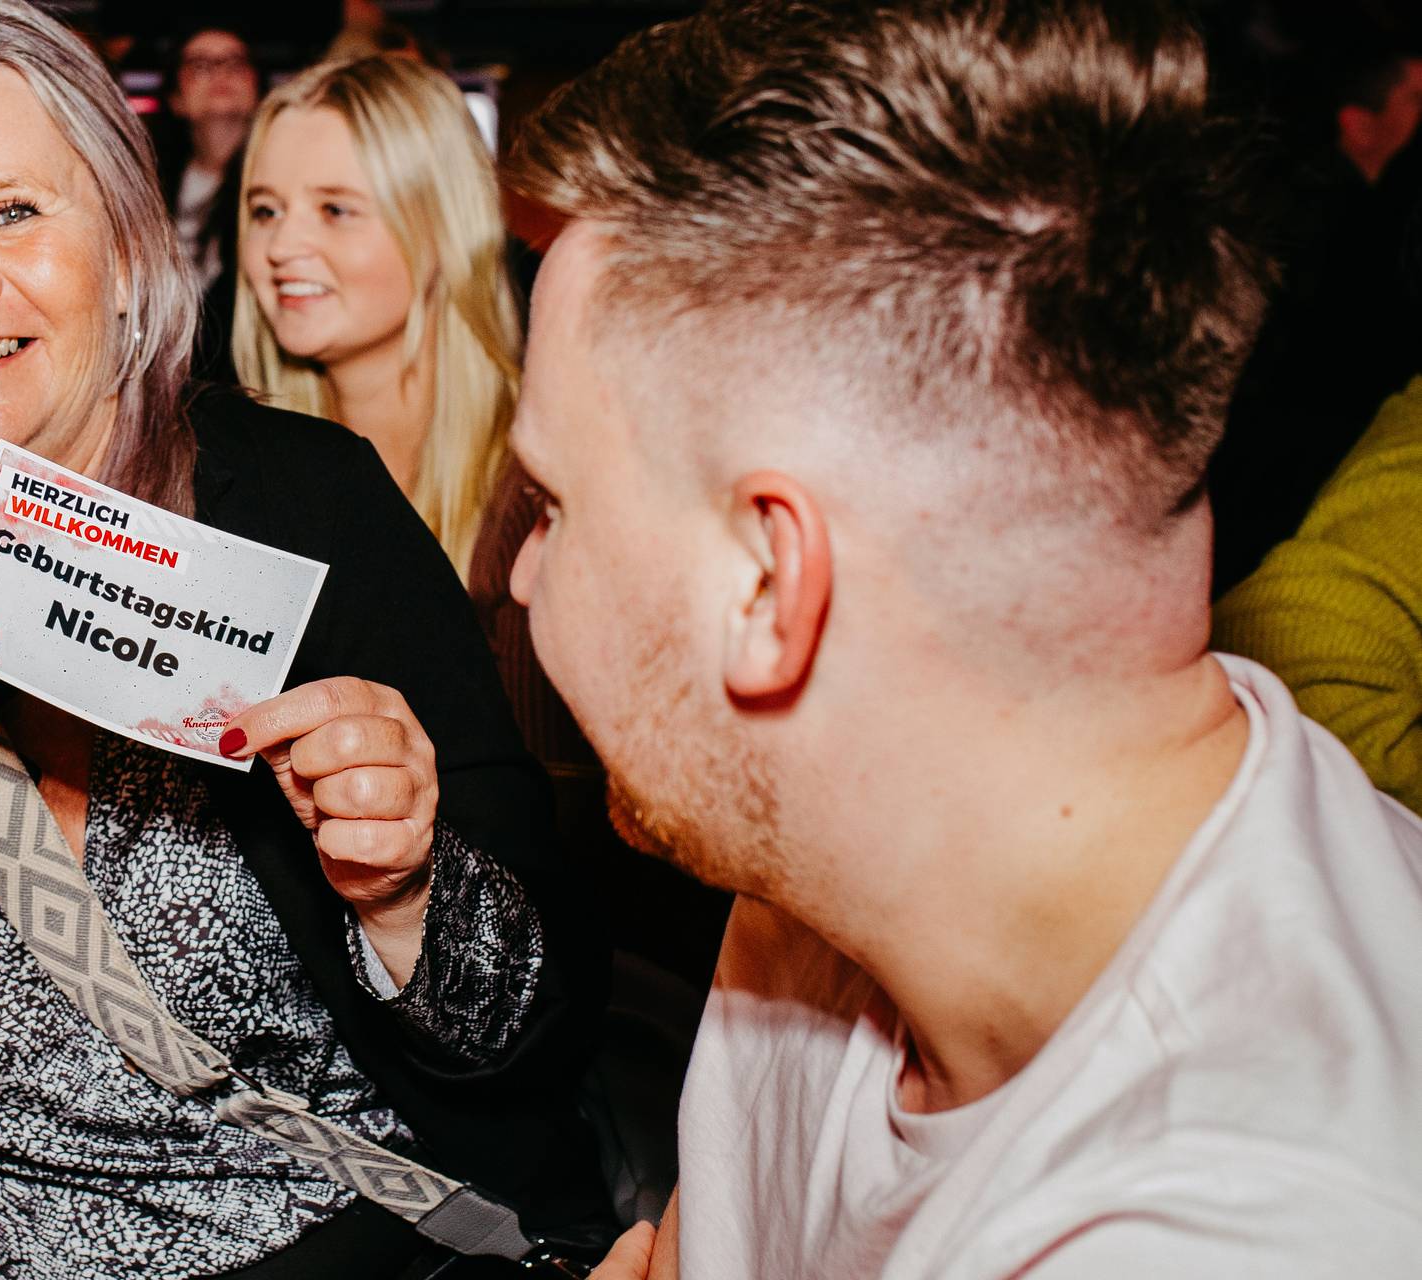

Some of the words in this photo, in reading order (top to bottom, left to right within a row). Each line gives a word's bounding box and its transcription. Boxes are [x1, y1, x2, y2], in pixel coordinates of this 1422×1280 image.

[11, 473, 130, 529] HERZLICH
[11, 495, 179, 569] WILLKOMMEN
[45, 600, 179, 677] Nicole
